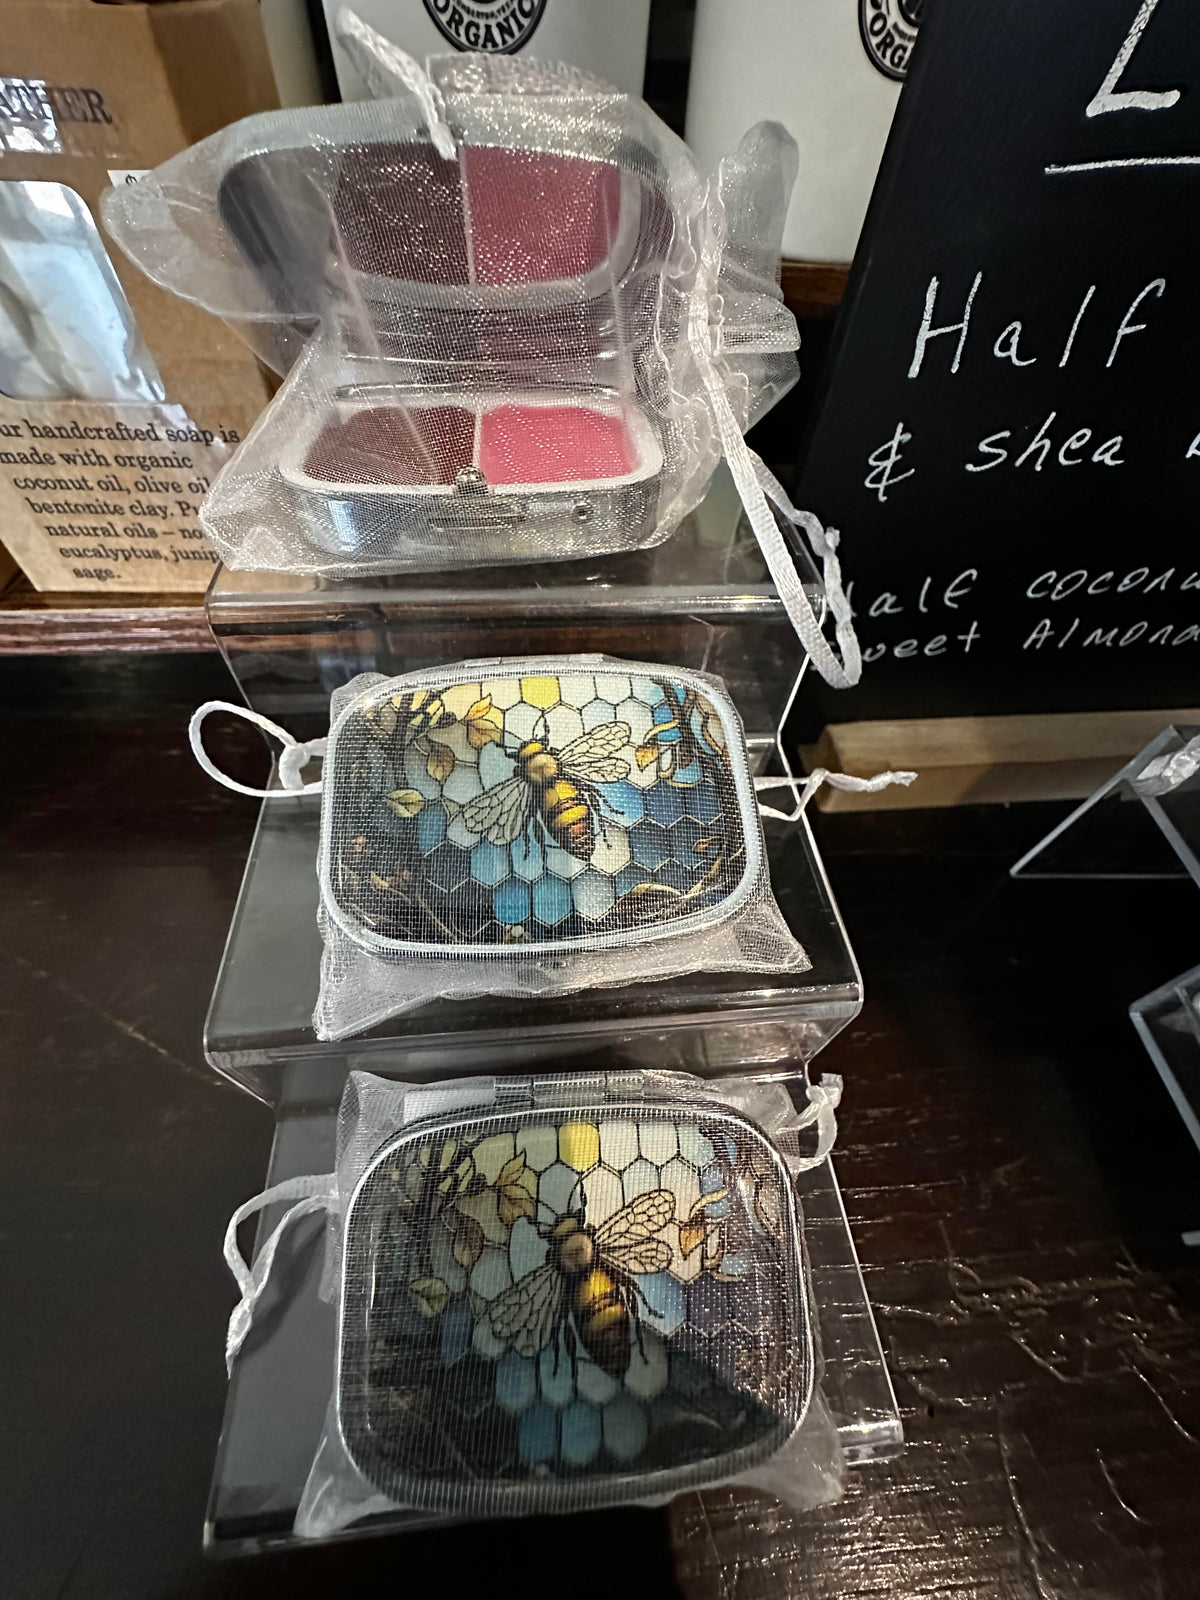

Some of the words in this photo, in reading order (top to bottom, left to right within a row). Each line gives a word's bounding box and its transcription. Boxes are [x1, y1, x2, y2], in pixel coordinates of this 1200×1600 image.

[908, 271, 1166, 379] Half
[22, 418, 162, 442] handcrafted
[166, 429, 215, 447] soap
[220, 424, 241, 443] is
[0, 447, 56, 465] made
[59, 449, 111, 467] with
[114, 451, 193, 471] organic
[864, 422, 915, 502] &
[965, 411, 1124, 473] shea
[13, 476, 93, 491] coconut
[97, 474, 131, 495] oil,
[134, 475, 183, 493] olive
[25, 498, 125, 515] bentonite
[129, 500, 175, 520] clay.
[44, 524, 121, 538] natural
[124, 526, 158, 539] oils
[59, 545, 169, 562] eucalyptus,
[73, 568, 122, 582] sage.
